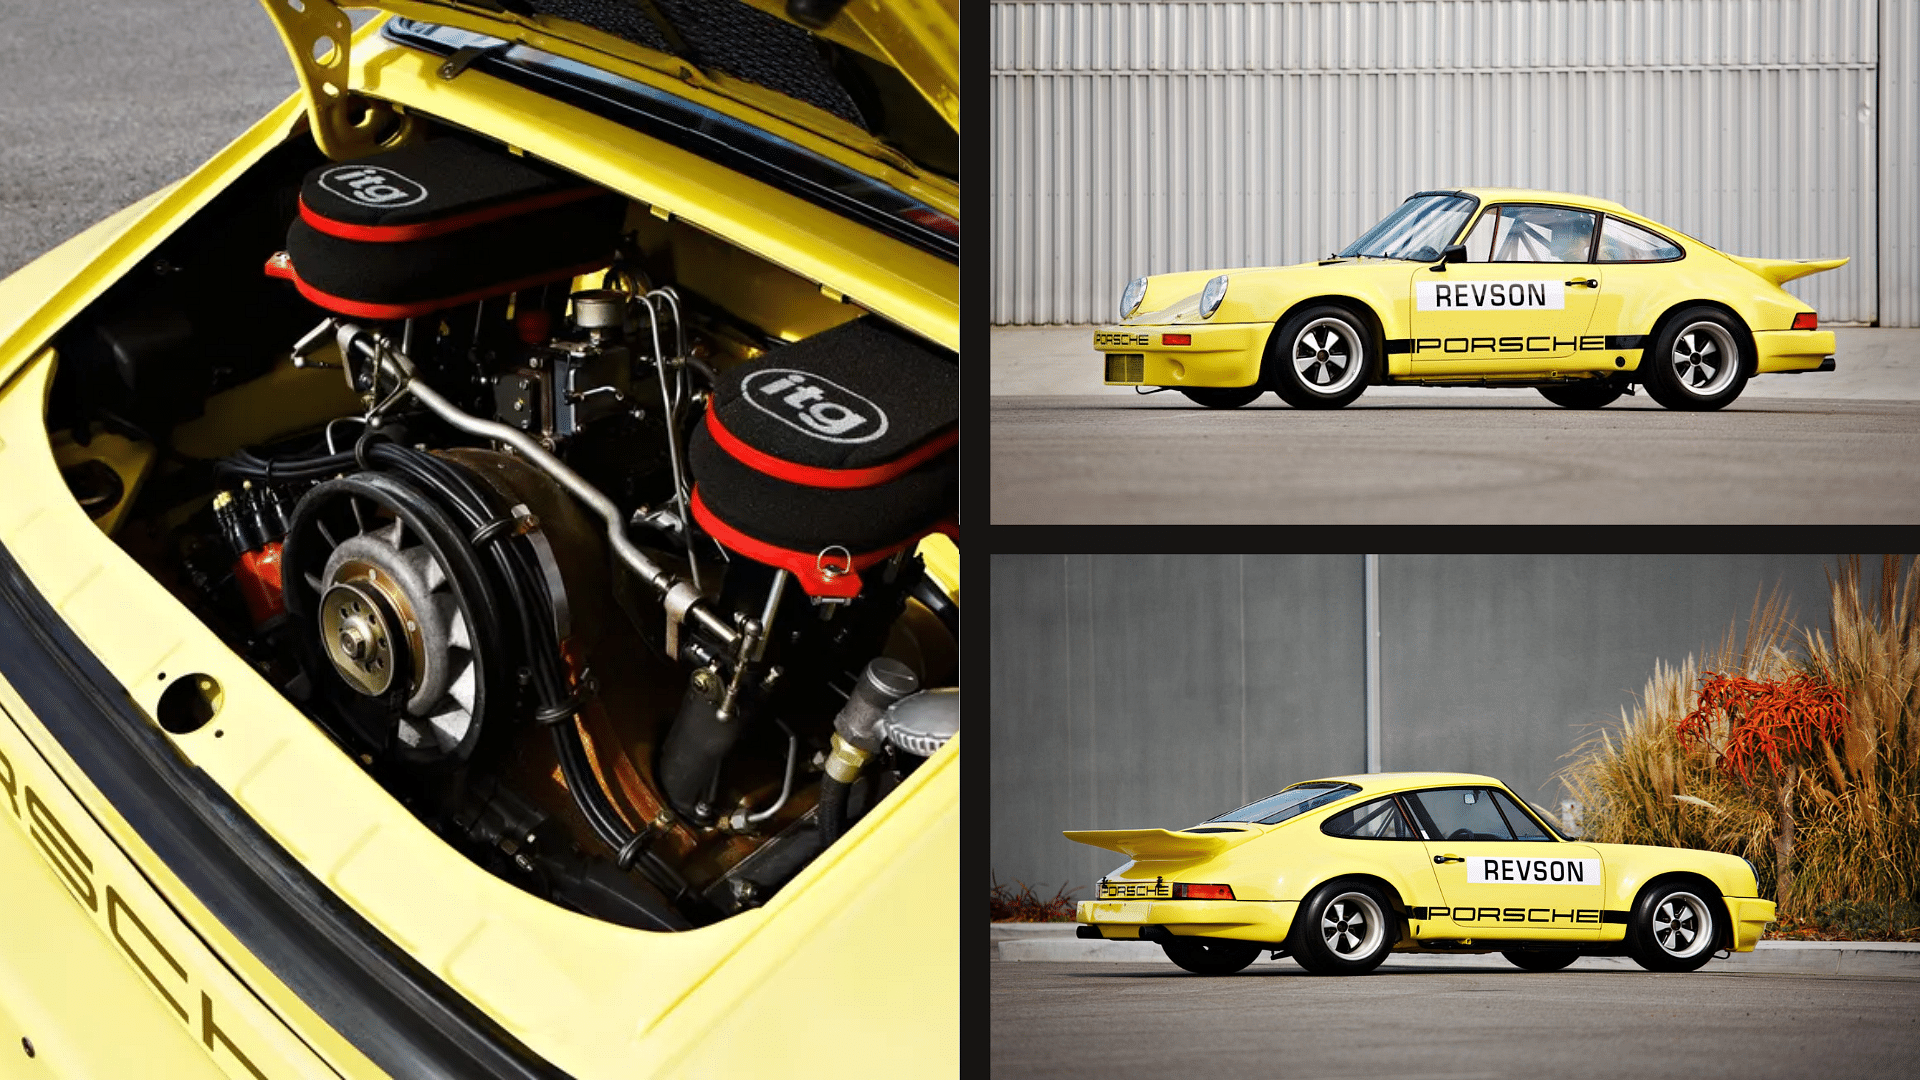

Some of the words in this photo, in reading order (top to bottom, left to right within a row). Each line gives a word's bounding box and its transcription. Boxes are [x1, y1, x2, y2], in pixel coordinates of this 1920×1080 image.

[334, 169, 409, 202] itg
[1435, 283, 1546, 307] REVSON
[1094, 333, 1149, 346] PORSCHE
[1416, 335, 1604, 353] PORSCHE
[759, 374, 867, 435] itg
[1484, 859, 1583, 882] REVSON
[1101, 885, 1169, 897] PORSCHE
[1428, 907, 1599, 923] PORSCHE
